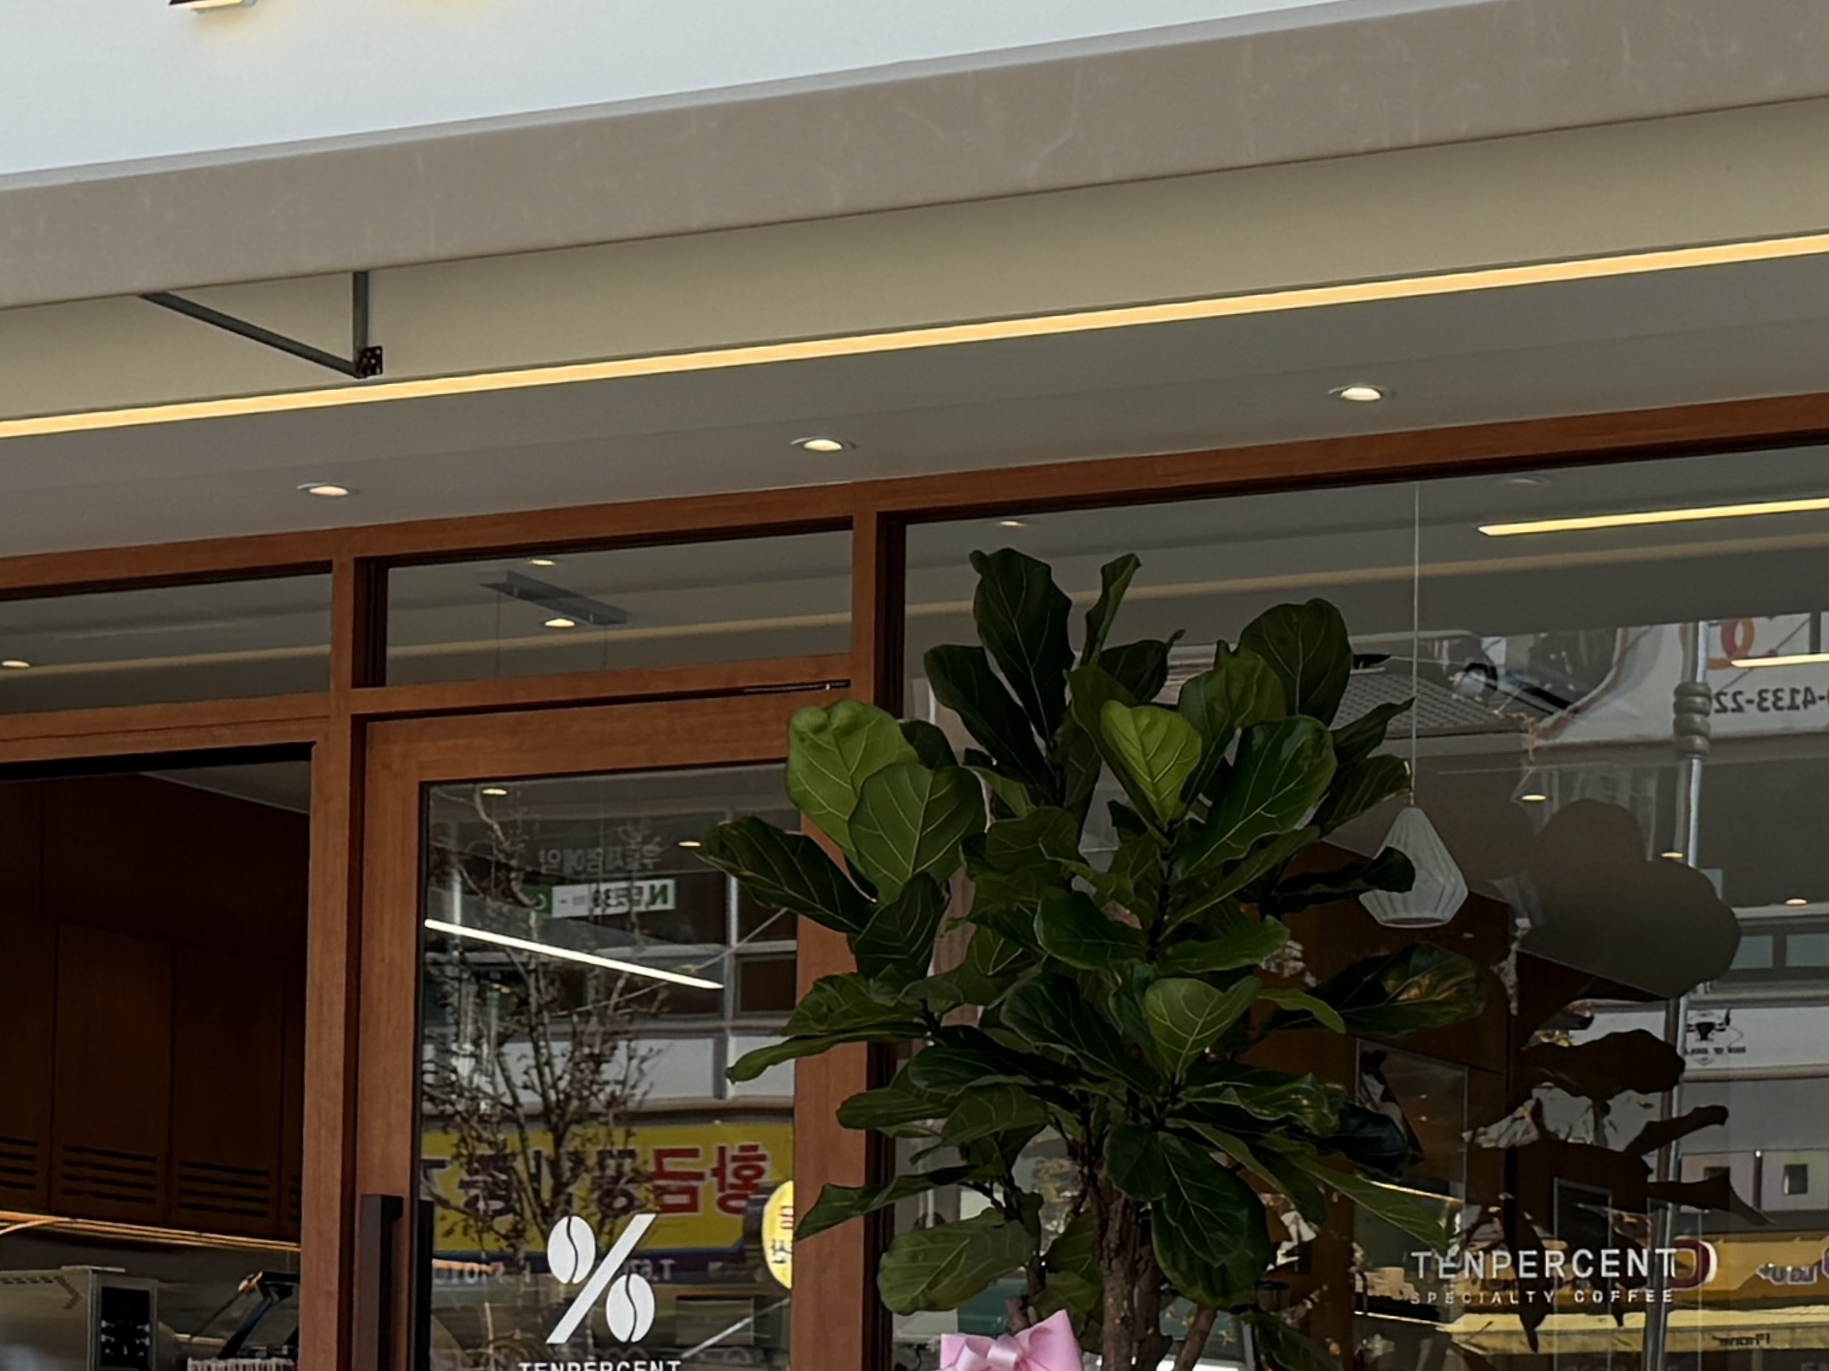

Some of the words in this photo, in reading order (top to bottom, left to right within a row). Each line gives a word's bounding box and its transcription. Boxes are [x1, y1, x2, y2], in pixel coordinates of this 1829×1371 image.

[1411, 1248, 1677, 1281] TENPERCENT
[1411, 1289, 1556, 1305] SPECIALTY
[1574, 1289, 1675, 1304] COFFEE
